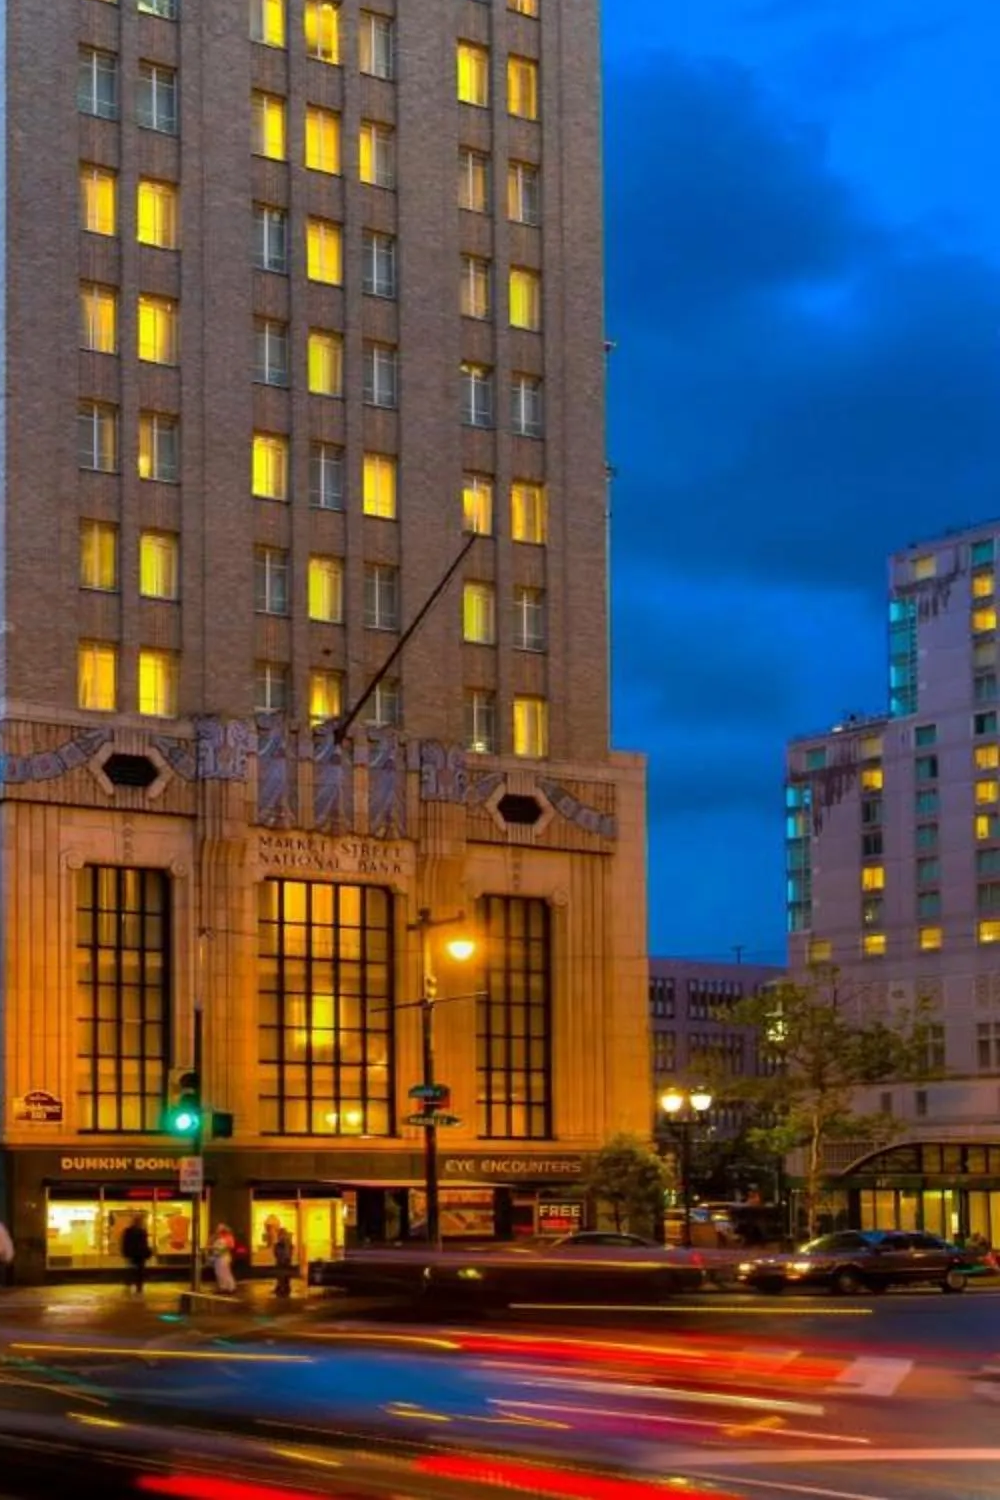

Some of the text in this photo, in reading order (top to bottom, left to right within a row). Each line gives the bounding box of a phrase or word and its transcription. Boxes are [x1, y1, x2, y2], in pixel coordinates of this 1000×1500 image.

[258, 835, 402, 858] MARKET STREET
[258, 851, 401, 874] NATIONAL BANK
[61, 1157, 181, 1171] DUNKIN' DONU
[445, 1159, 582, 1173] EYE ENCOUNTERS
[539, 1204, 581, 1218] FREE
